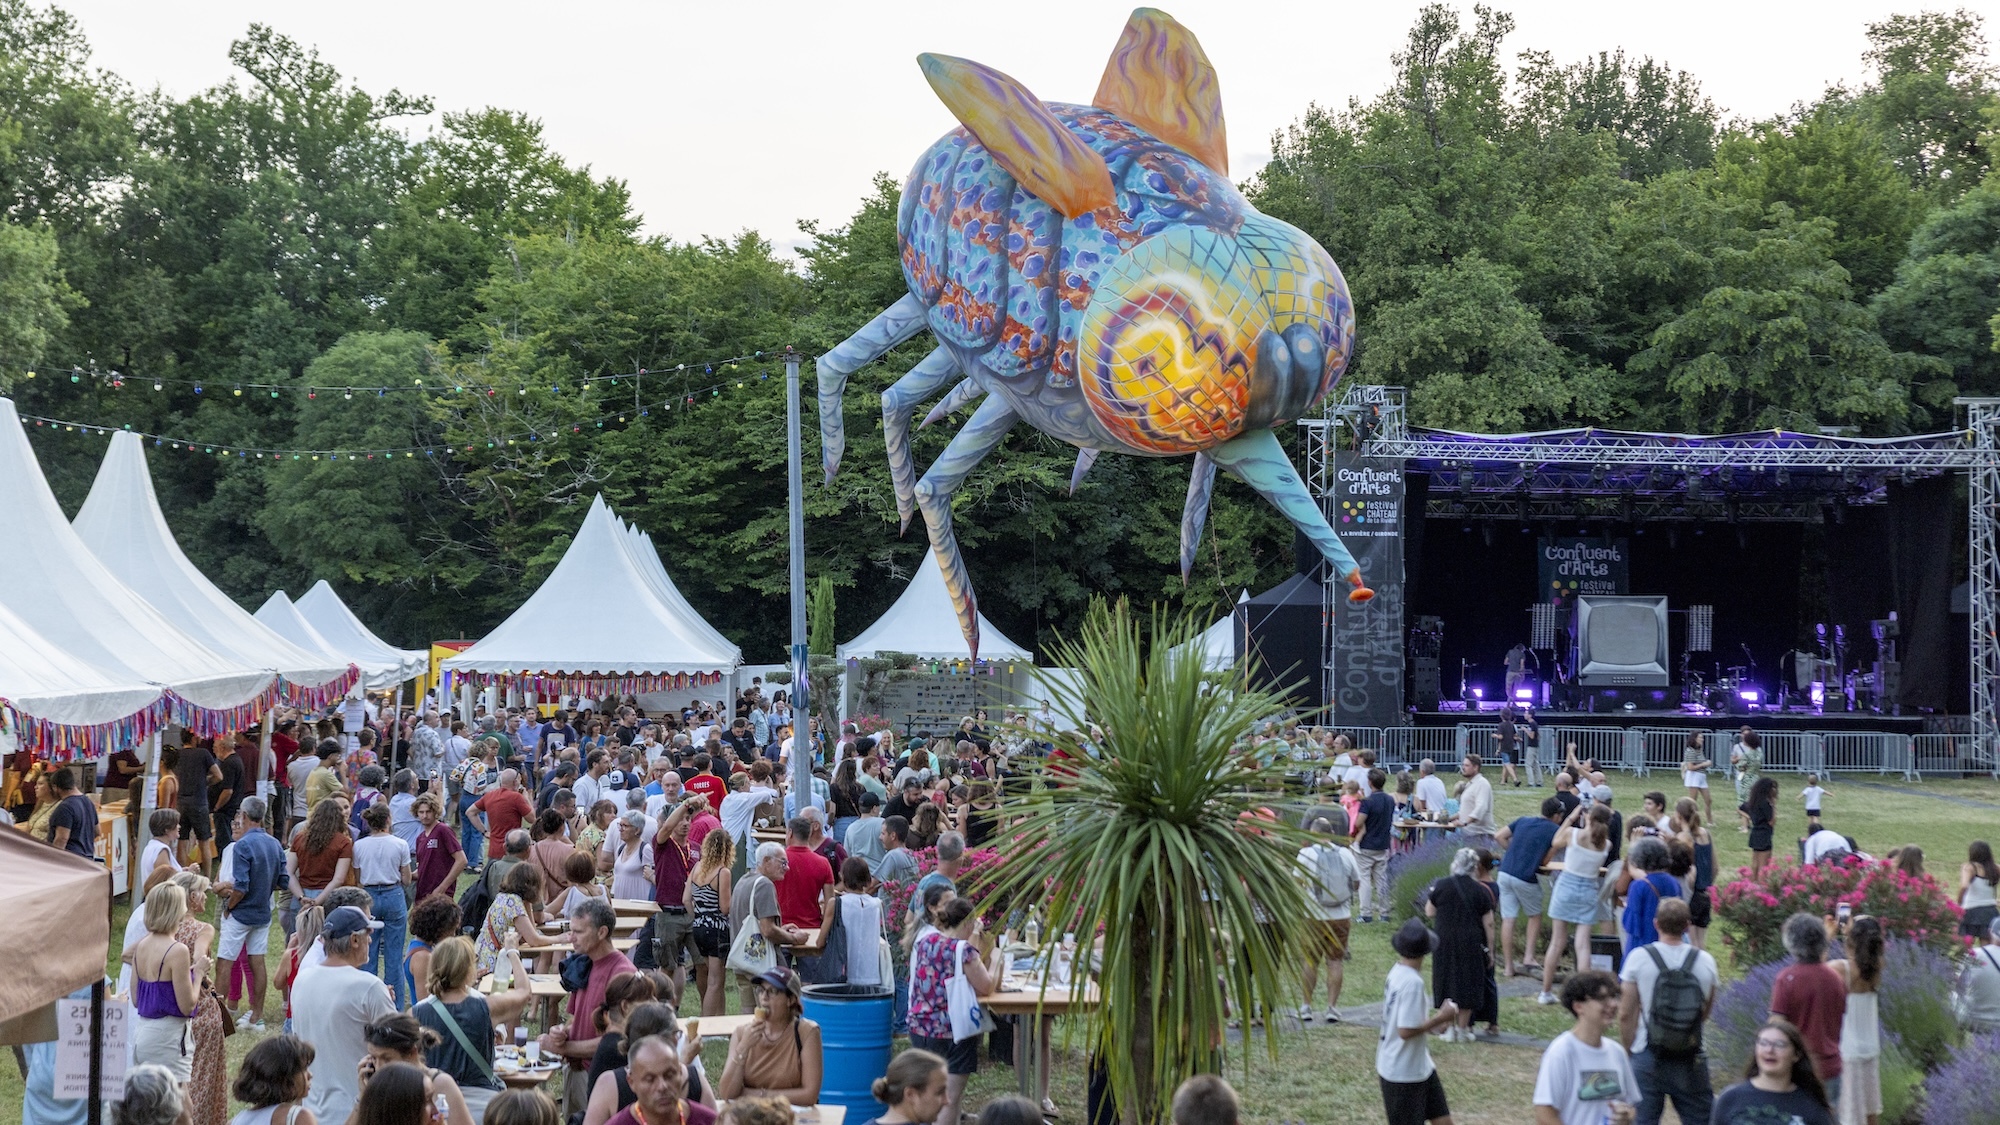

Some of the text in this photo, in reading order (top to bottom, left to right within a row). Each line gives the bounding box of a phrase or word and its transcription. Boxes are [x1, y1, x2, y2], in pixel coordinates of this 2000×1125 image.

[1338, 466, 1401, 483] Confluent
[1348, 482, 1391, 495] d'Arts
[1545, 542, 1622, 562] Confluent
[1558, 561, 1609, 577] d'Arts
[693, 781, 710, 789] TORRES
